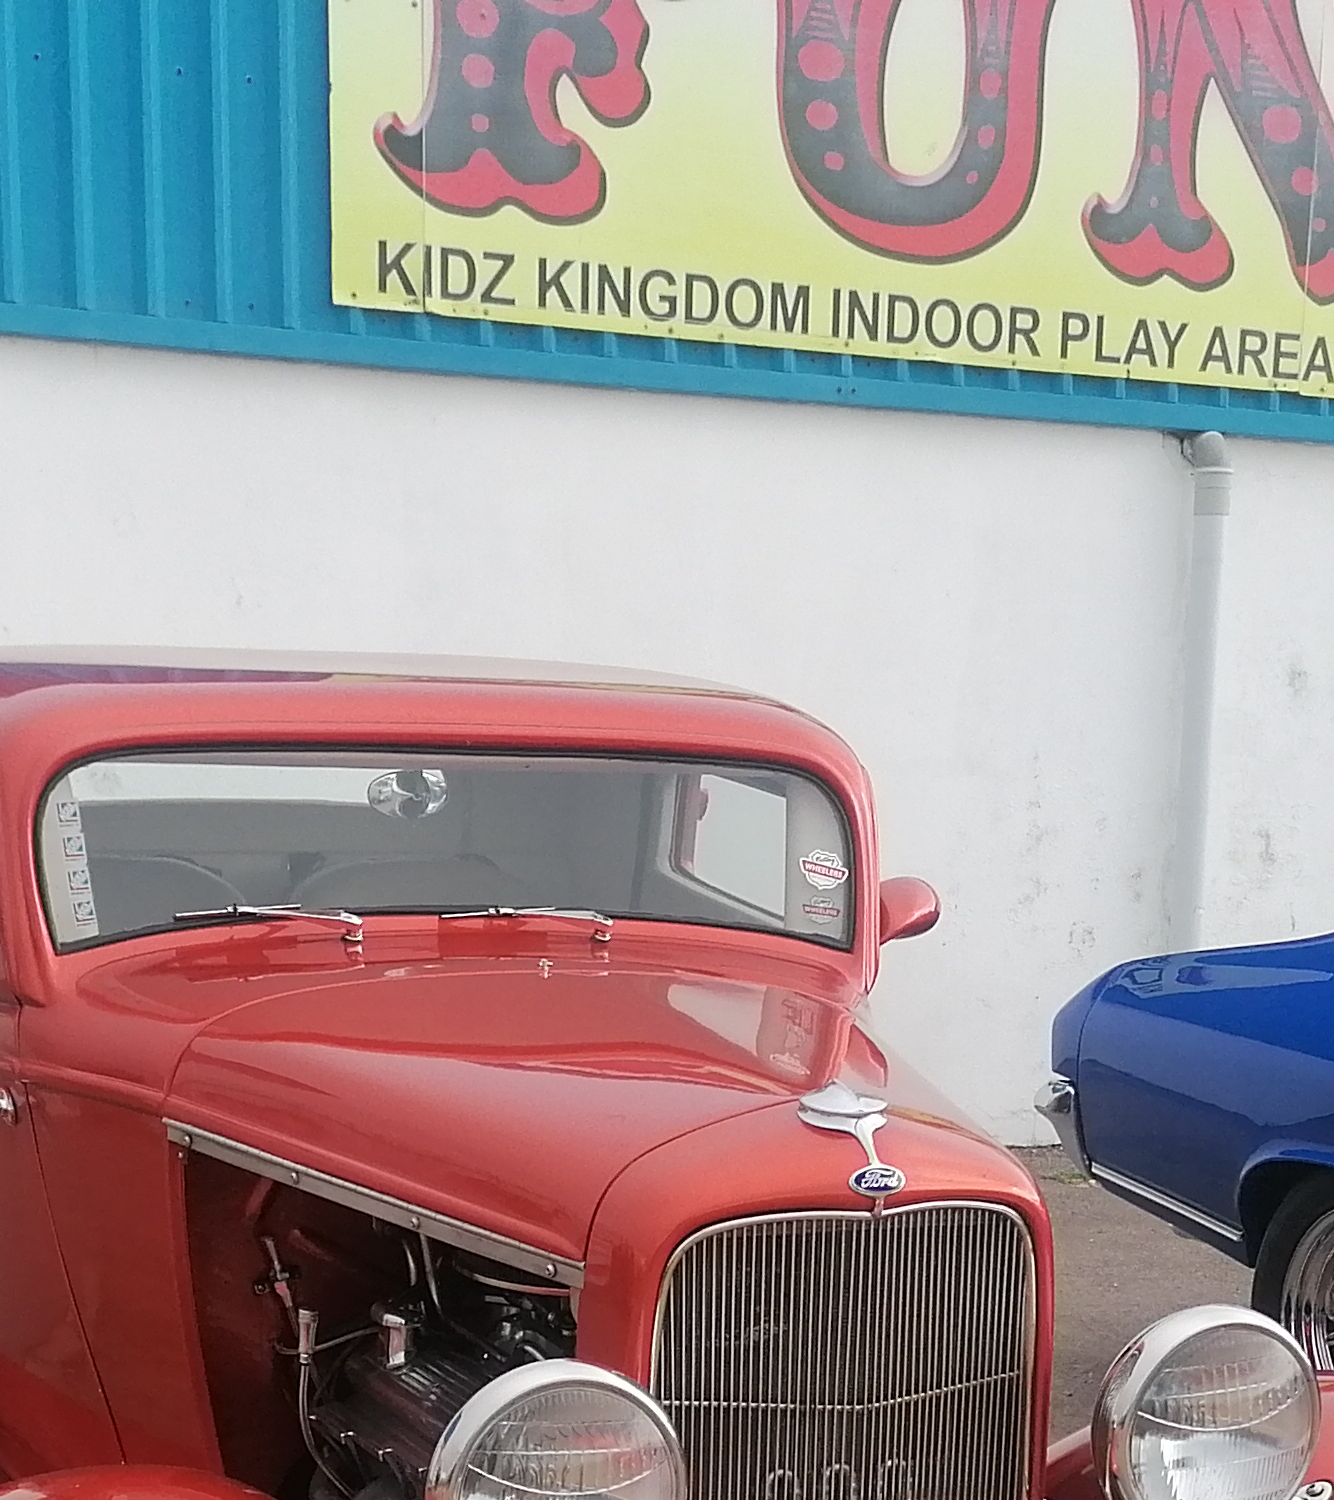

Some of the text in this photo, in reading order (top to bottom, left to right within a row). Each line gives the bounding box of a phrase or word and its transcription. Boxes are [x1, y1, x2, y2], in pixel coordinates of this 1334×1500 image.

[377, 239, 516, 306] KIDZ
[537, 256, 811, 335] KINGDOM
[832, 287, 1041, 358] INDOOR
[1059, 311, 1189, 370] PLAY
[861, 1168, 899, 1189] Ford
